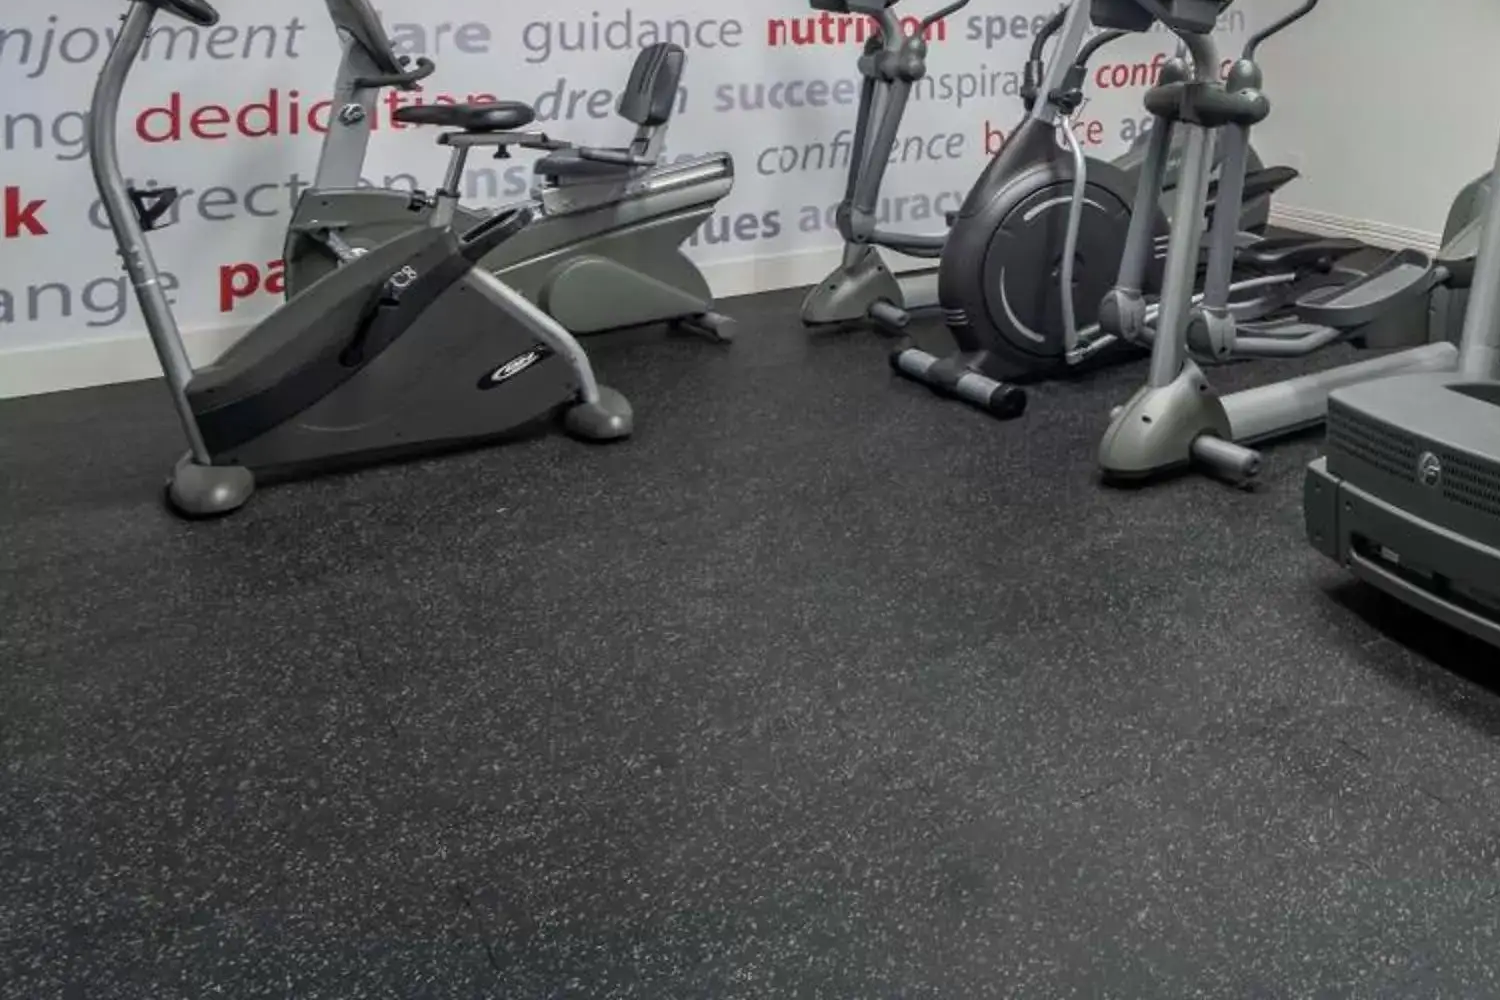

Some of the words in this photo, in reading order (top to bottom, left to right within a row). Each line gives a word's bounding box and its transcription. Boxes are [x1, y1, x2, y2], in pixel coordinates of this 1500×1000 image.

[378, 10, 491, 54] are
[523, 11, 743, 64] guidance
[966, 3, 1064, 49] spee
[5, 110, 89, 160] ng
[714, 77, 858, 113] succee
[756, 129, 965, 176] confience
